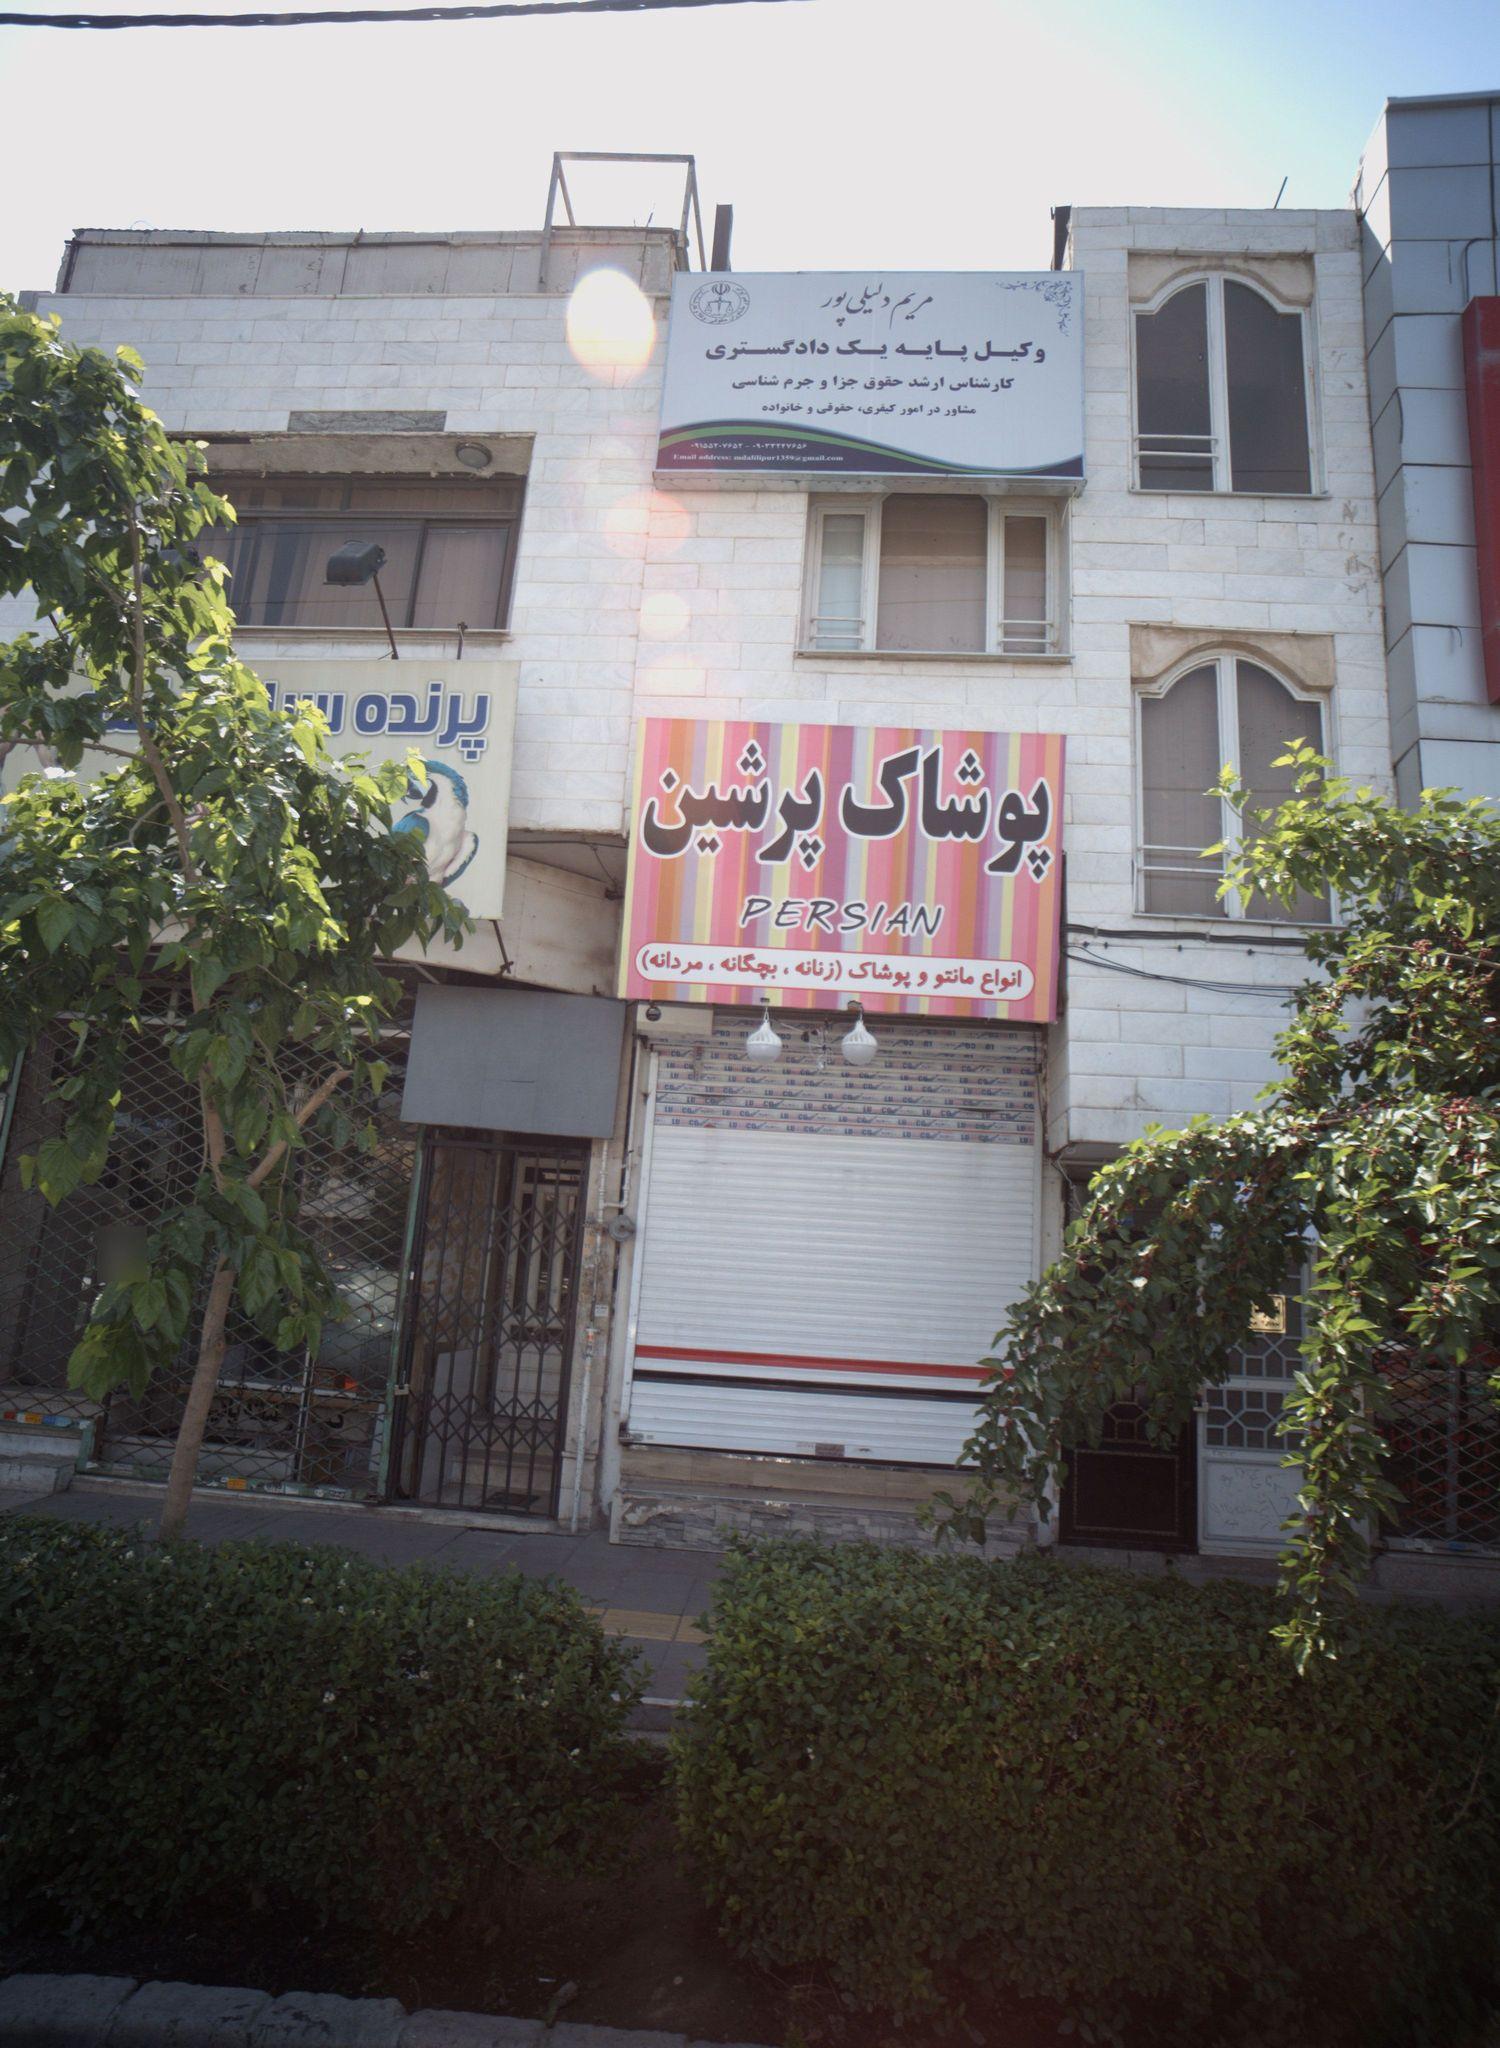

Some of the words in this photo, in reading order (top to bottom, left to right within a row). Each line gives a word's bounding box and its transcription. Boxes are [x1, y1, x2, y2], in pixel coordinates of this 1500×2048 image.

[846, 282, 891, 314] دلیلی
[819, 291, 848, 328] پور
[889, 292, 934, 329] مریم
[705, 339, 830, 360] دادگستری
[836, 339, 887, 360] یک
[895, 339, 968, 362] پایه
[974, 340, 1046, 363] وکیل
[732, 374, 779, 390] شناسی
[783, 376, 815, 390] جرم
[820, 379, 828, 390] و
[833, 374, 858, 390] جزا
[863, 375, 903, 390] حقوق
[908, 376, 945, 391] ارشد
[949, 377, 1015, 392] کارشناس
[761, 402, 803, 413] خانواده
[806, 406, 814, 415] و
[816, 402, 853, 415] حقوقی
[899, 404, 924, 417] امور
[927, 405, 940, 416] در
[944, 403, 977, 416] مشاور
[673, 453, 697, 461] Email
[353, 680, 493, 764] پرنده
[640, 738, 827, 870] پرشین
[840, 745, 1053, 881] پوشاک
[739, 897, 944, 937] PERSIAN
[720, 953, 778, 980] بچگانه
[848, 962, 911, 988] پوشاک
[917, 970, 928, 986] و
[933, 966, 975, 989] مانتو
[980, 969, 1023, 995] انواع
